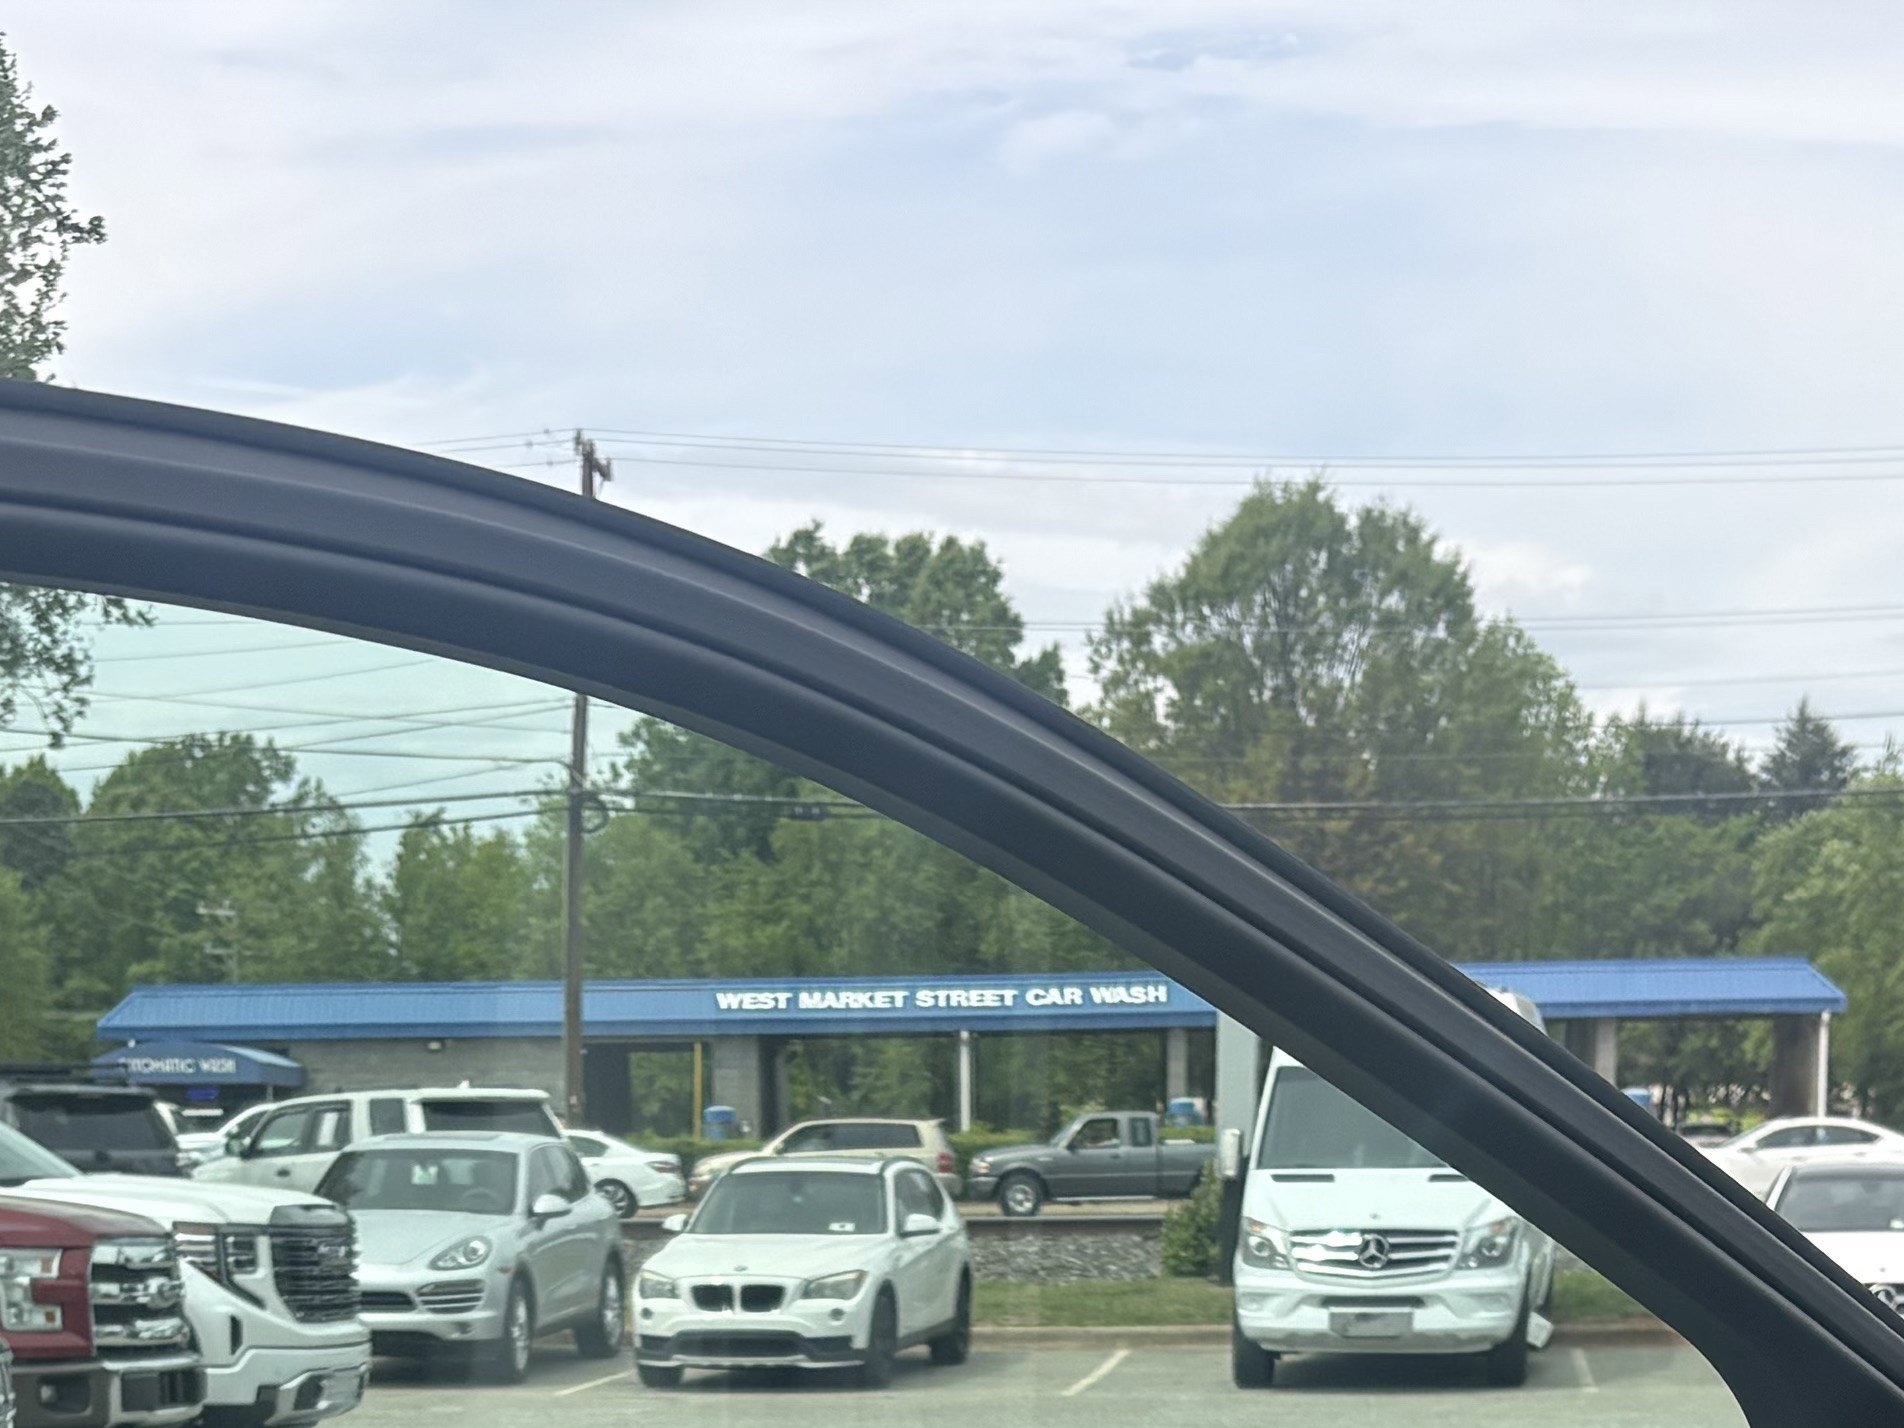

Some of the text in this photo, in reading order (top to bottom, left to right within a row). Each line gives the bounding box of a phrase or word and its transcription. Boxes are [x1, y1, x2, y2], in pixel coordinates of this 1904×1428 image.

[715, 985, 1168, 1011] WEST MARKET STREET CAR WASH
